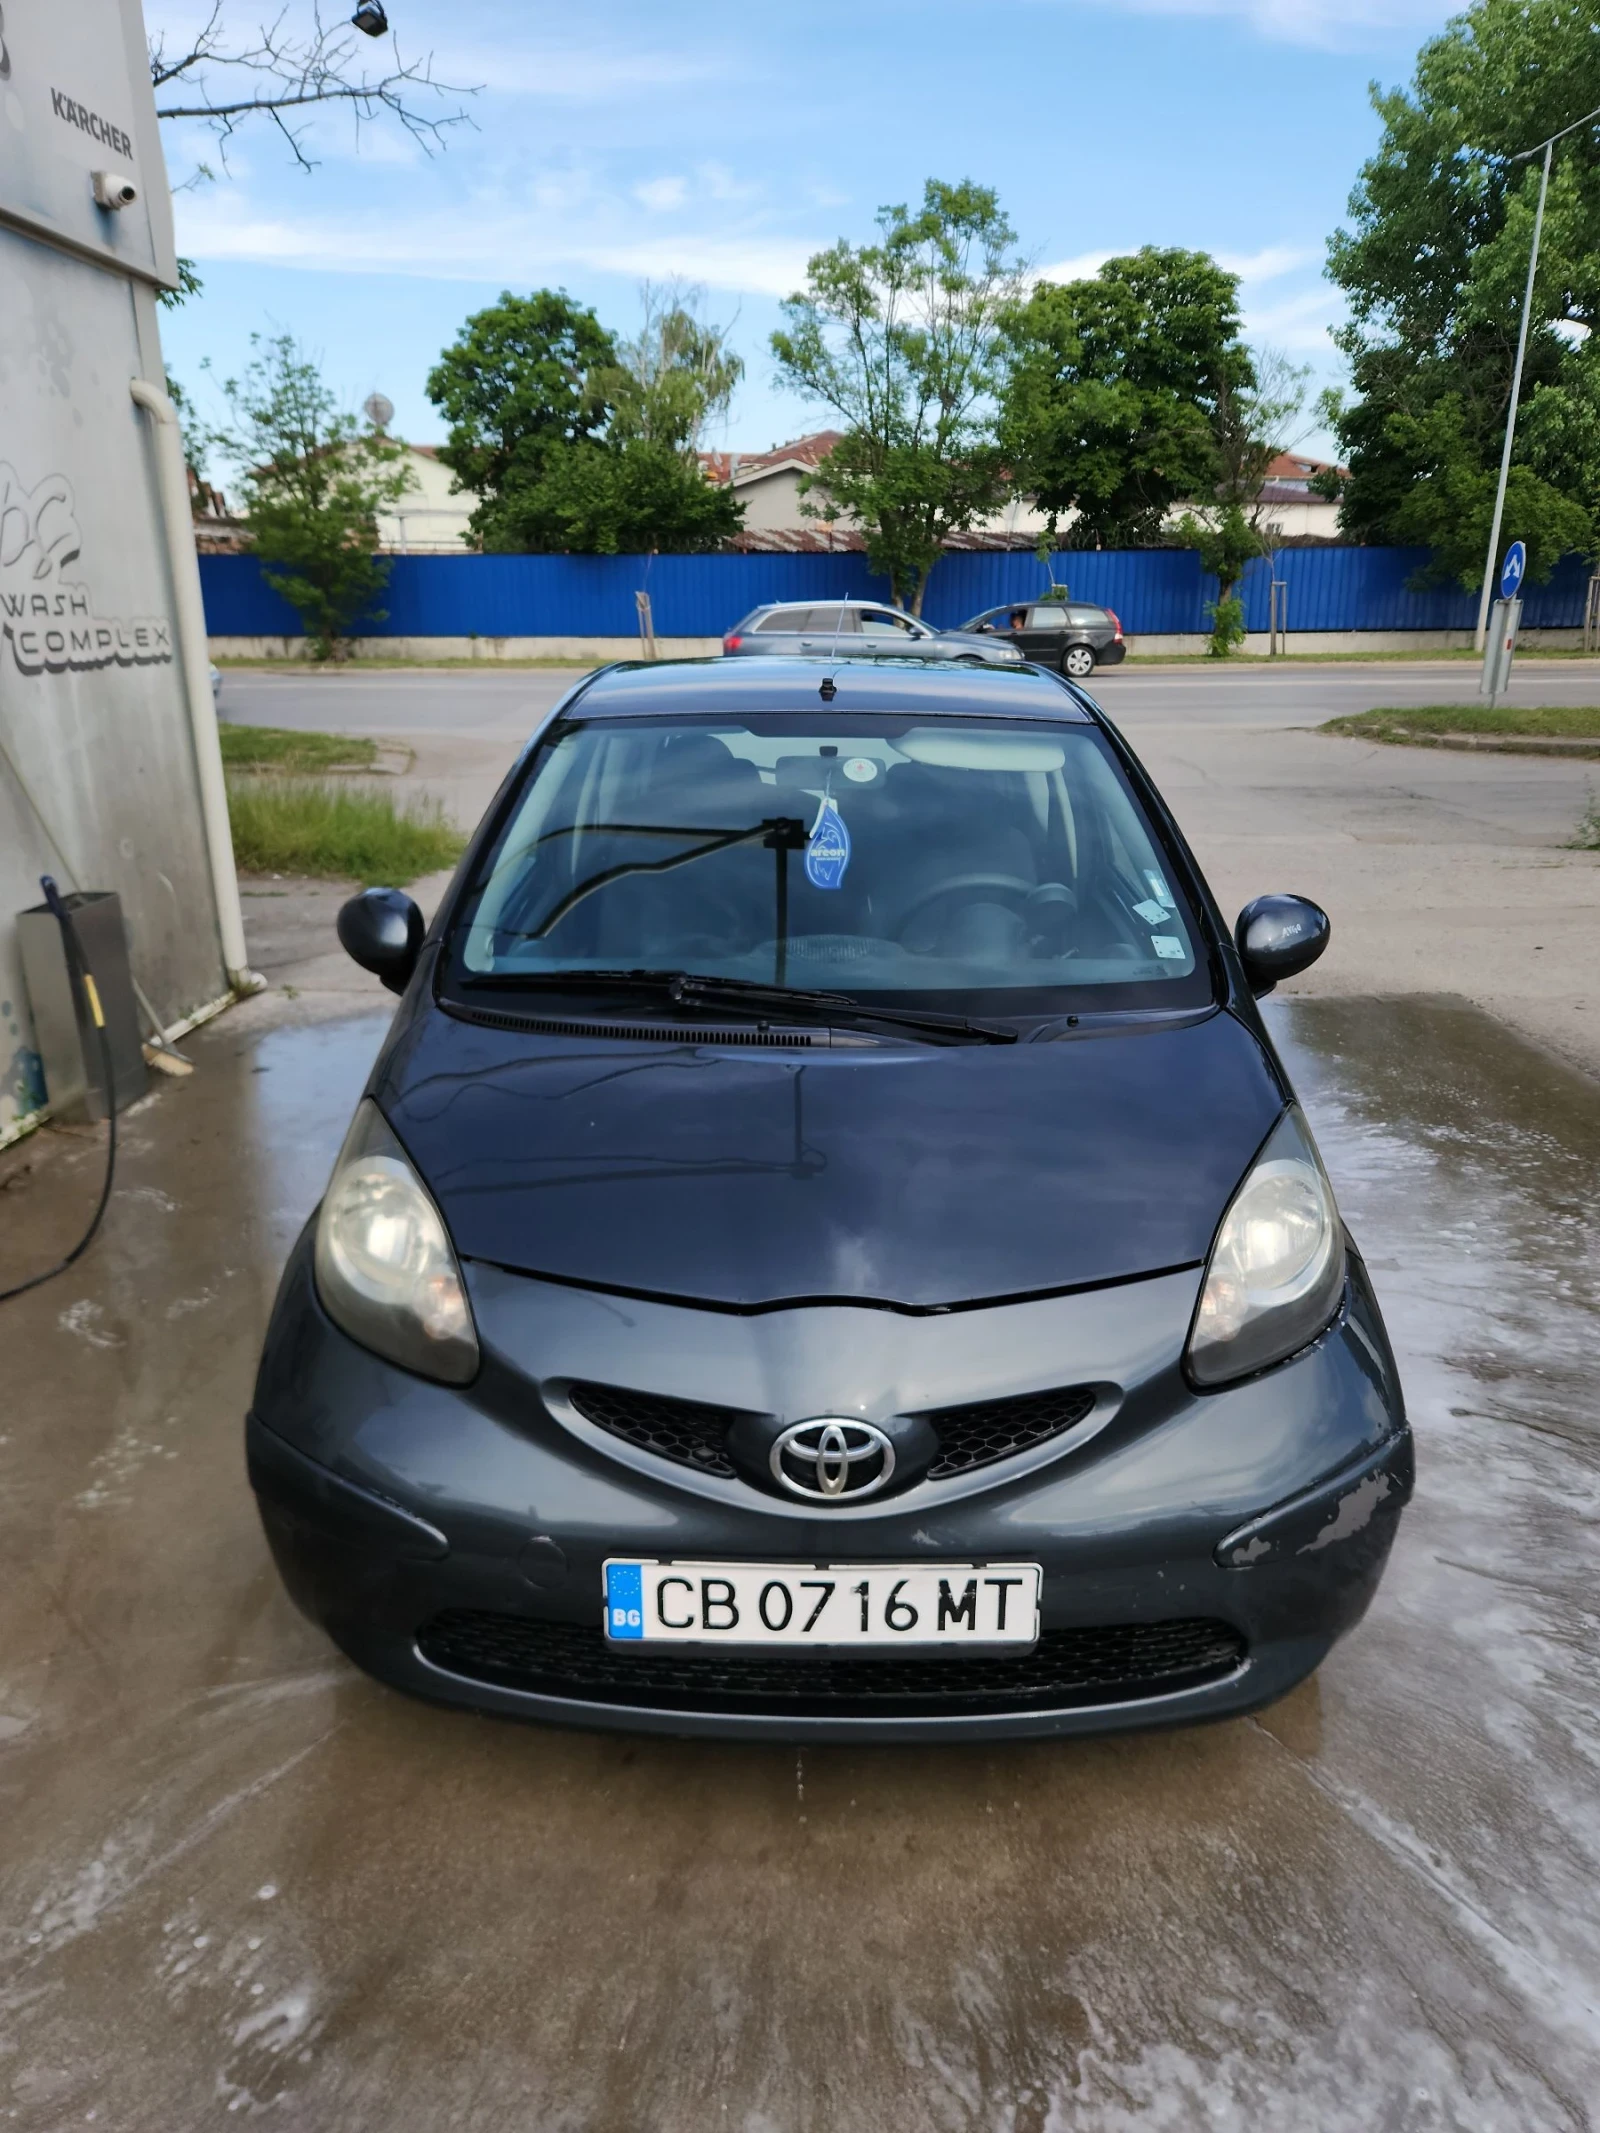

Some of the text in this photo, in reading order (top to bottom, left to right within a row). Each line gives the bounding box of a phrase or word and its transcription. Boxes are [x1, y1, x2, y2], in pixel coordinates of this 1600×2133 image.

[51, 86, 134, 161] KÄRCHER
[0, 593, 89, 617] WASH
[19, 627, 170, 653] COMPLEX
[1282, 923, 1302, 938] AYGO
[657, 1577, 1023, 1632] CB 0716 MT
[612, 1608, 641, 1627] BG
